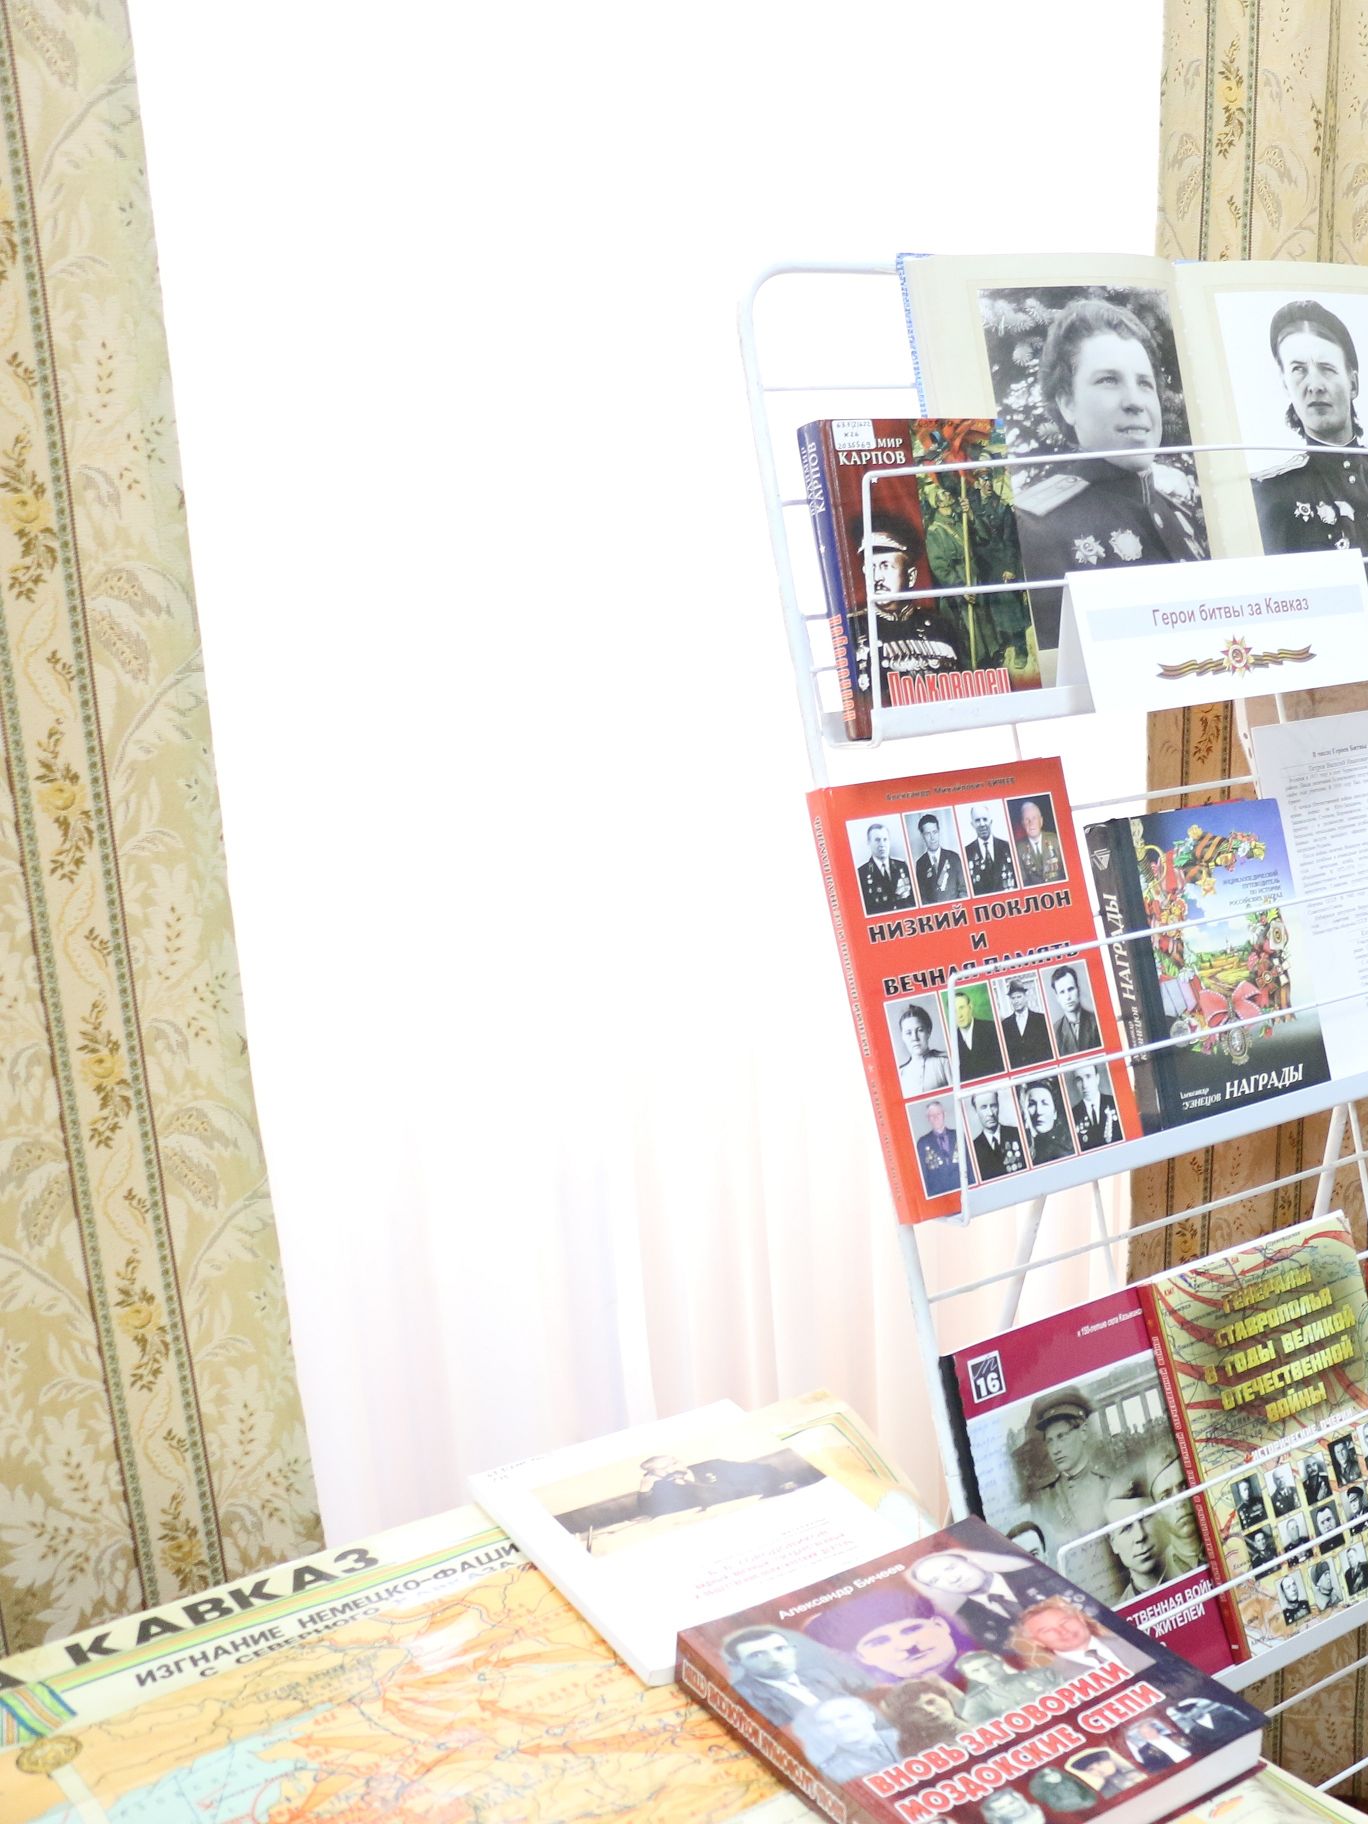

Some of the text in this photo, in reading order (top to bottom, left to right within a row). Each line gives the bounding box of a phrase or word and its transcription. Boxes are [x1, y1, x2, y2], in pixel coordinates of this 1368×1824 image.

[838, 451, 906, 465] КАРПОВ
[1152, 597, 1309, 629] Герои битвы за Кавказ
[867, 889, 1071, 944] НИЗКИЙ ПОКЛОН
[970, 931, 988, 951] И
[1182, 1093, 1221, 1110] УЗНЕЦОВ
[1225, 1064, 1303, 1099] НАГРАДЫ
[1215, 1287, 1332, 1348] СТАВРОПОЛЬЯ
[1223, 1268, 1312, 1313] ГЕНЕРАЛЫ
[1205, 1304, 1356, 1385] В ГОДЫ ВЕЛИКОЙ
[1221, 1334, 1354, 1410] ОТЕЧЕСТВЕННОЙ
[976, 1373, 1001, 1395] 16
[1265, 1382, 1327, 1423] ВОЙНЫ
[64, 1548, 380, 1667] КАВКАЗ
[136, 1542, 522, 1687] ИЗГНАНИЕ НЕМЕЦКО-ФАШИ
[778, 1564, 905, 1620] Александр Бичеев
[199, 1666, 219, 1678] С
[235, 1607, 380, 1665] СЕВЕРНОГО
[1155, 1602, 1205, 1638] ЖИТЕЛЕЙ
[865, 1661, 1131, 1795] ВНОВЬ ЗАГОВОРИЛИ
[897, 1726, 1084, 1824] МОЗДОКСКИЕ
[1080, 1683, 1163, 1731] СТЕПИ
